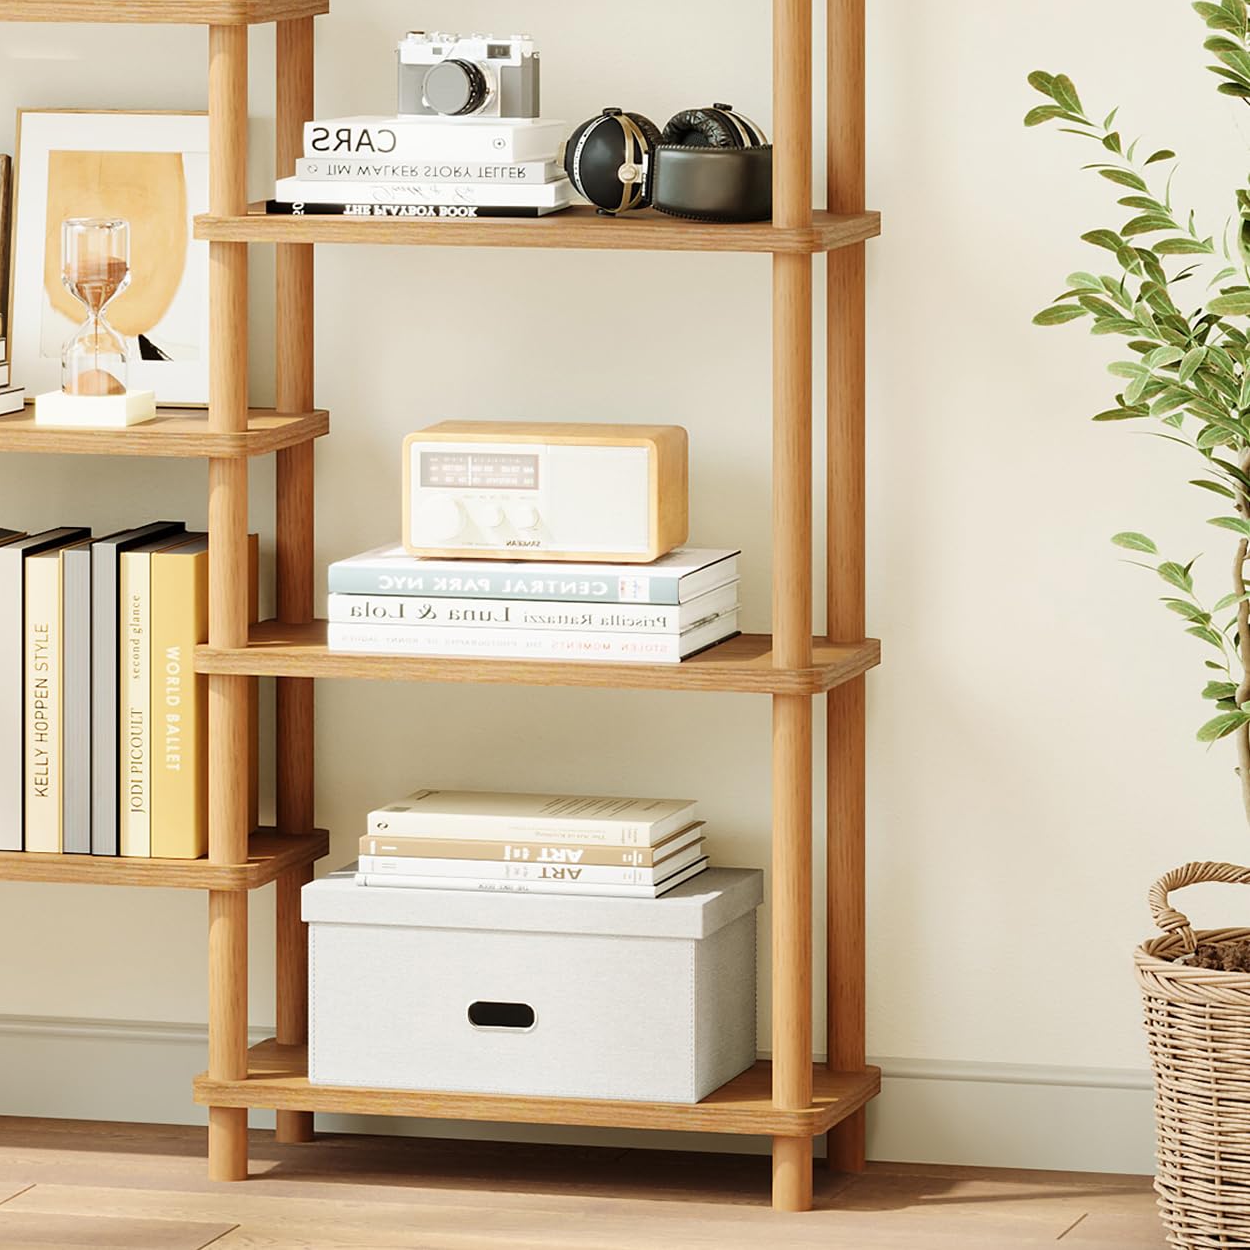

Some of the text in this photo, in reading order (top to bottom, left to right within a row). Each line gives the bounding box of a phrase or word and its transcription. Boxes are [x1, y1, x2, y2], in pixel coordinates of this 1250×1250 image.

[130, 594, 143, 680] second glance
[35, 624, 49, 797] KELLY HOPPEN STYLE
[165, 646, 181, 771] WORLD BALLET
[130, 707, 145, 813] JODI PICOULT
[537, 848, 585, 863] ART
[538, 866, 583, 879] ART
